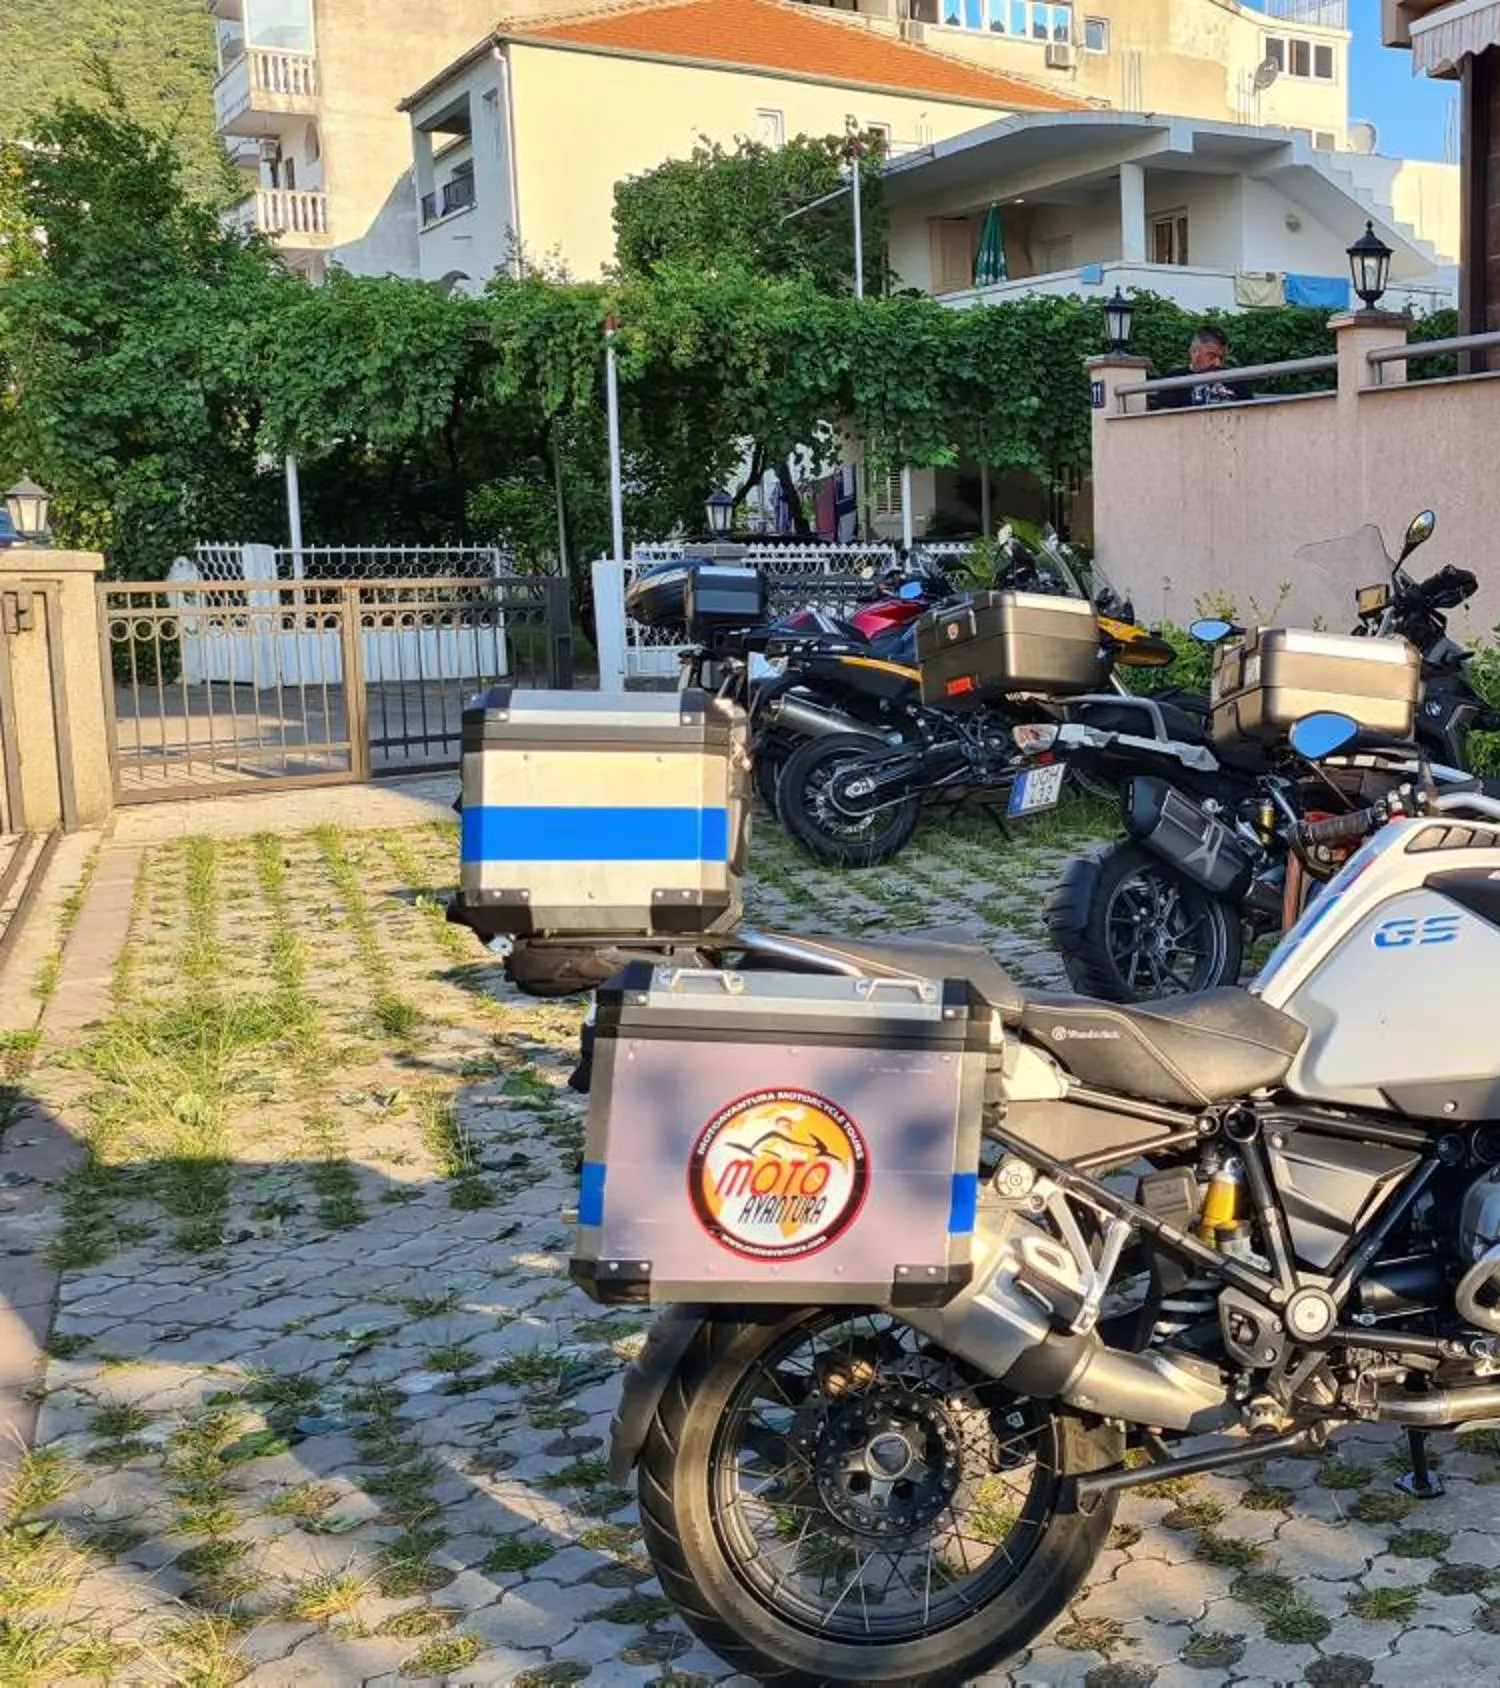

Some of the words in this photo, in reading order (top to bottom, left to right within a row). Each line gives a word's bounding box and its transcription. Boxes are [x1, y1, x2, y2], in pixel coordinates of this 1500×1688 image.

[1375, 915, 1461, 948] GS
[697, 1091, 776, 1156] MOTOAVANTURA
[777, 1091, 846, 1128] MOTORCYCLE
[843, 1119, 865, 1161] TOURS
[714, 1158, 832, 1197] MOTO
[738, 1195, 828, 1225] AVANTURA
